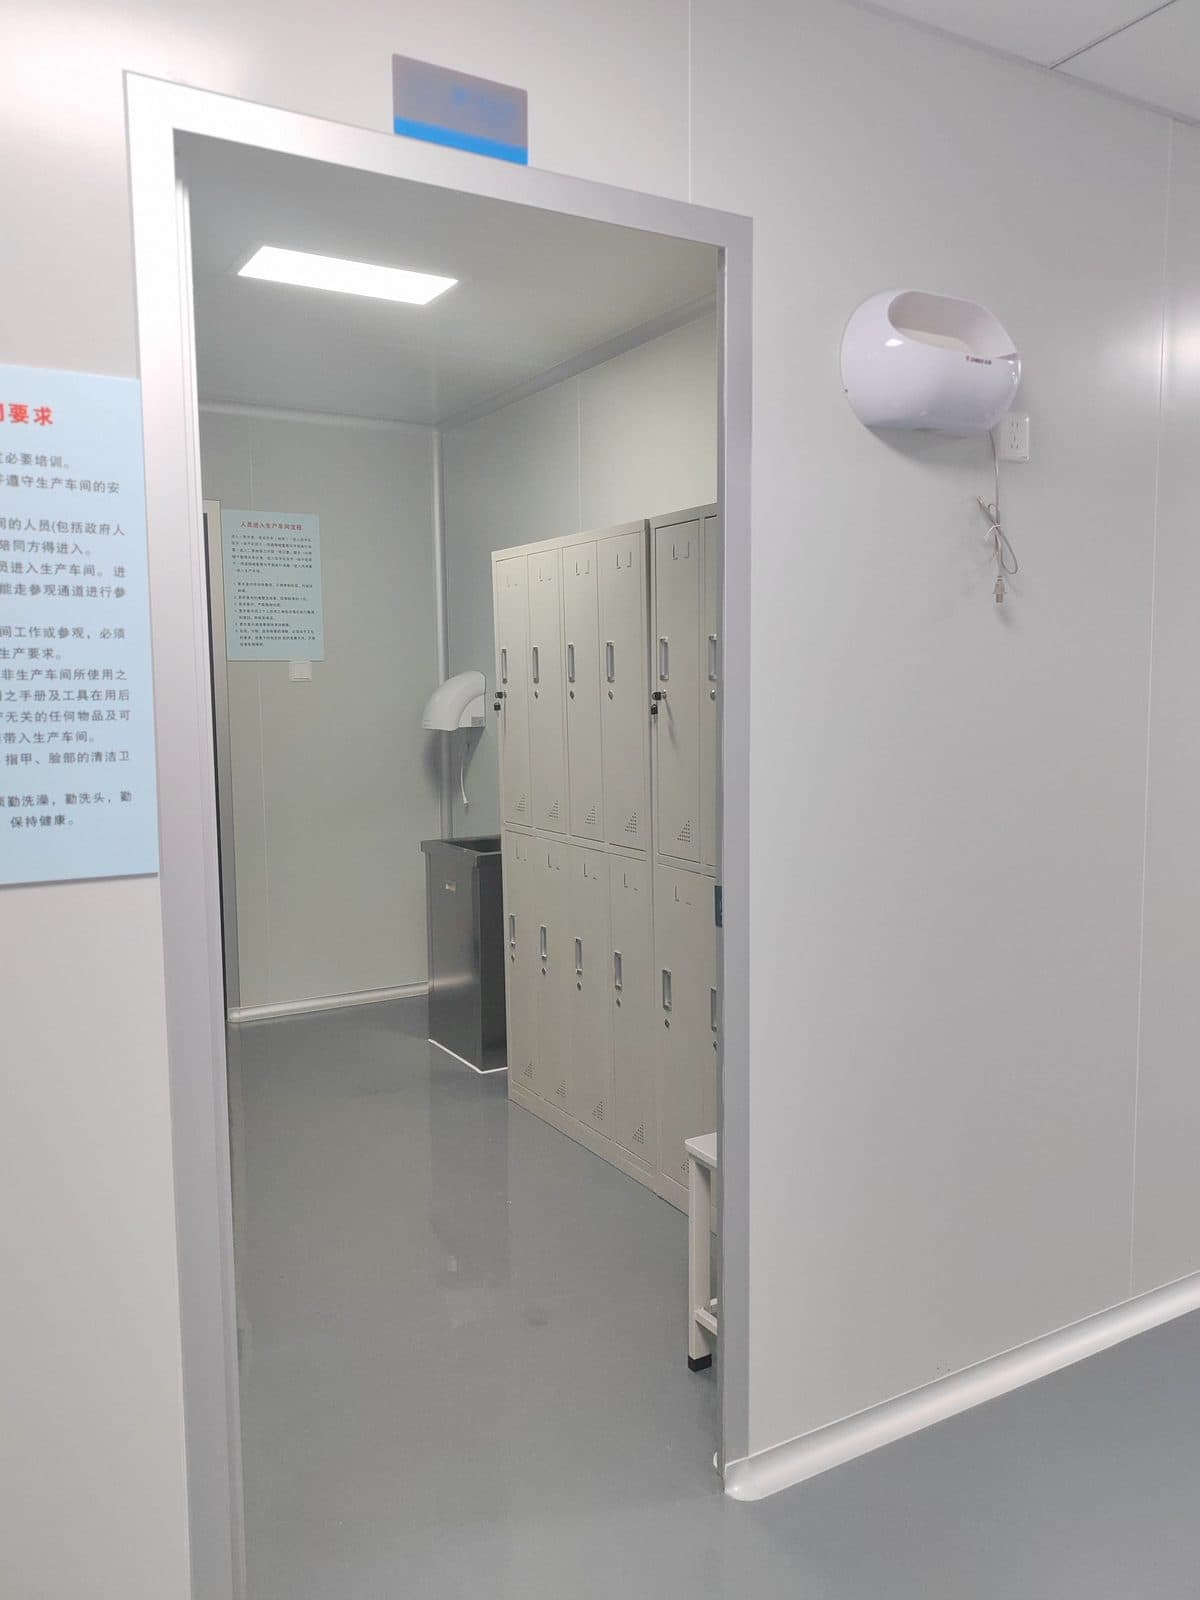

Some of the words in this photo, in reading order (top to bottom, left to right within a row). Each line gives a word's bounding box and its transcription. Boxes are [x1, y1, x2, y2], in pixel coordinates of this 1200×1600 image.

[0, 403, 54, 426] 要求
[0, 452, 69, 469] 必要培训。
[0, 689, 130, 702] 之手册及工具在用后
[0, 709, 131, 723] 无关的任何物品及可
[0, 730, 94, 744] 带入生产车间。
[10, 814, 73, 828] 保持健康。
